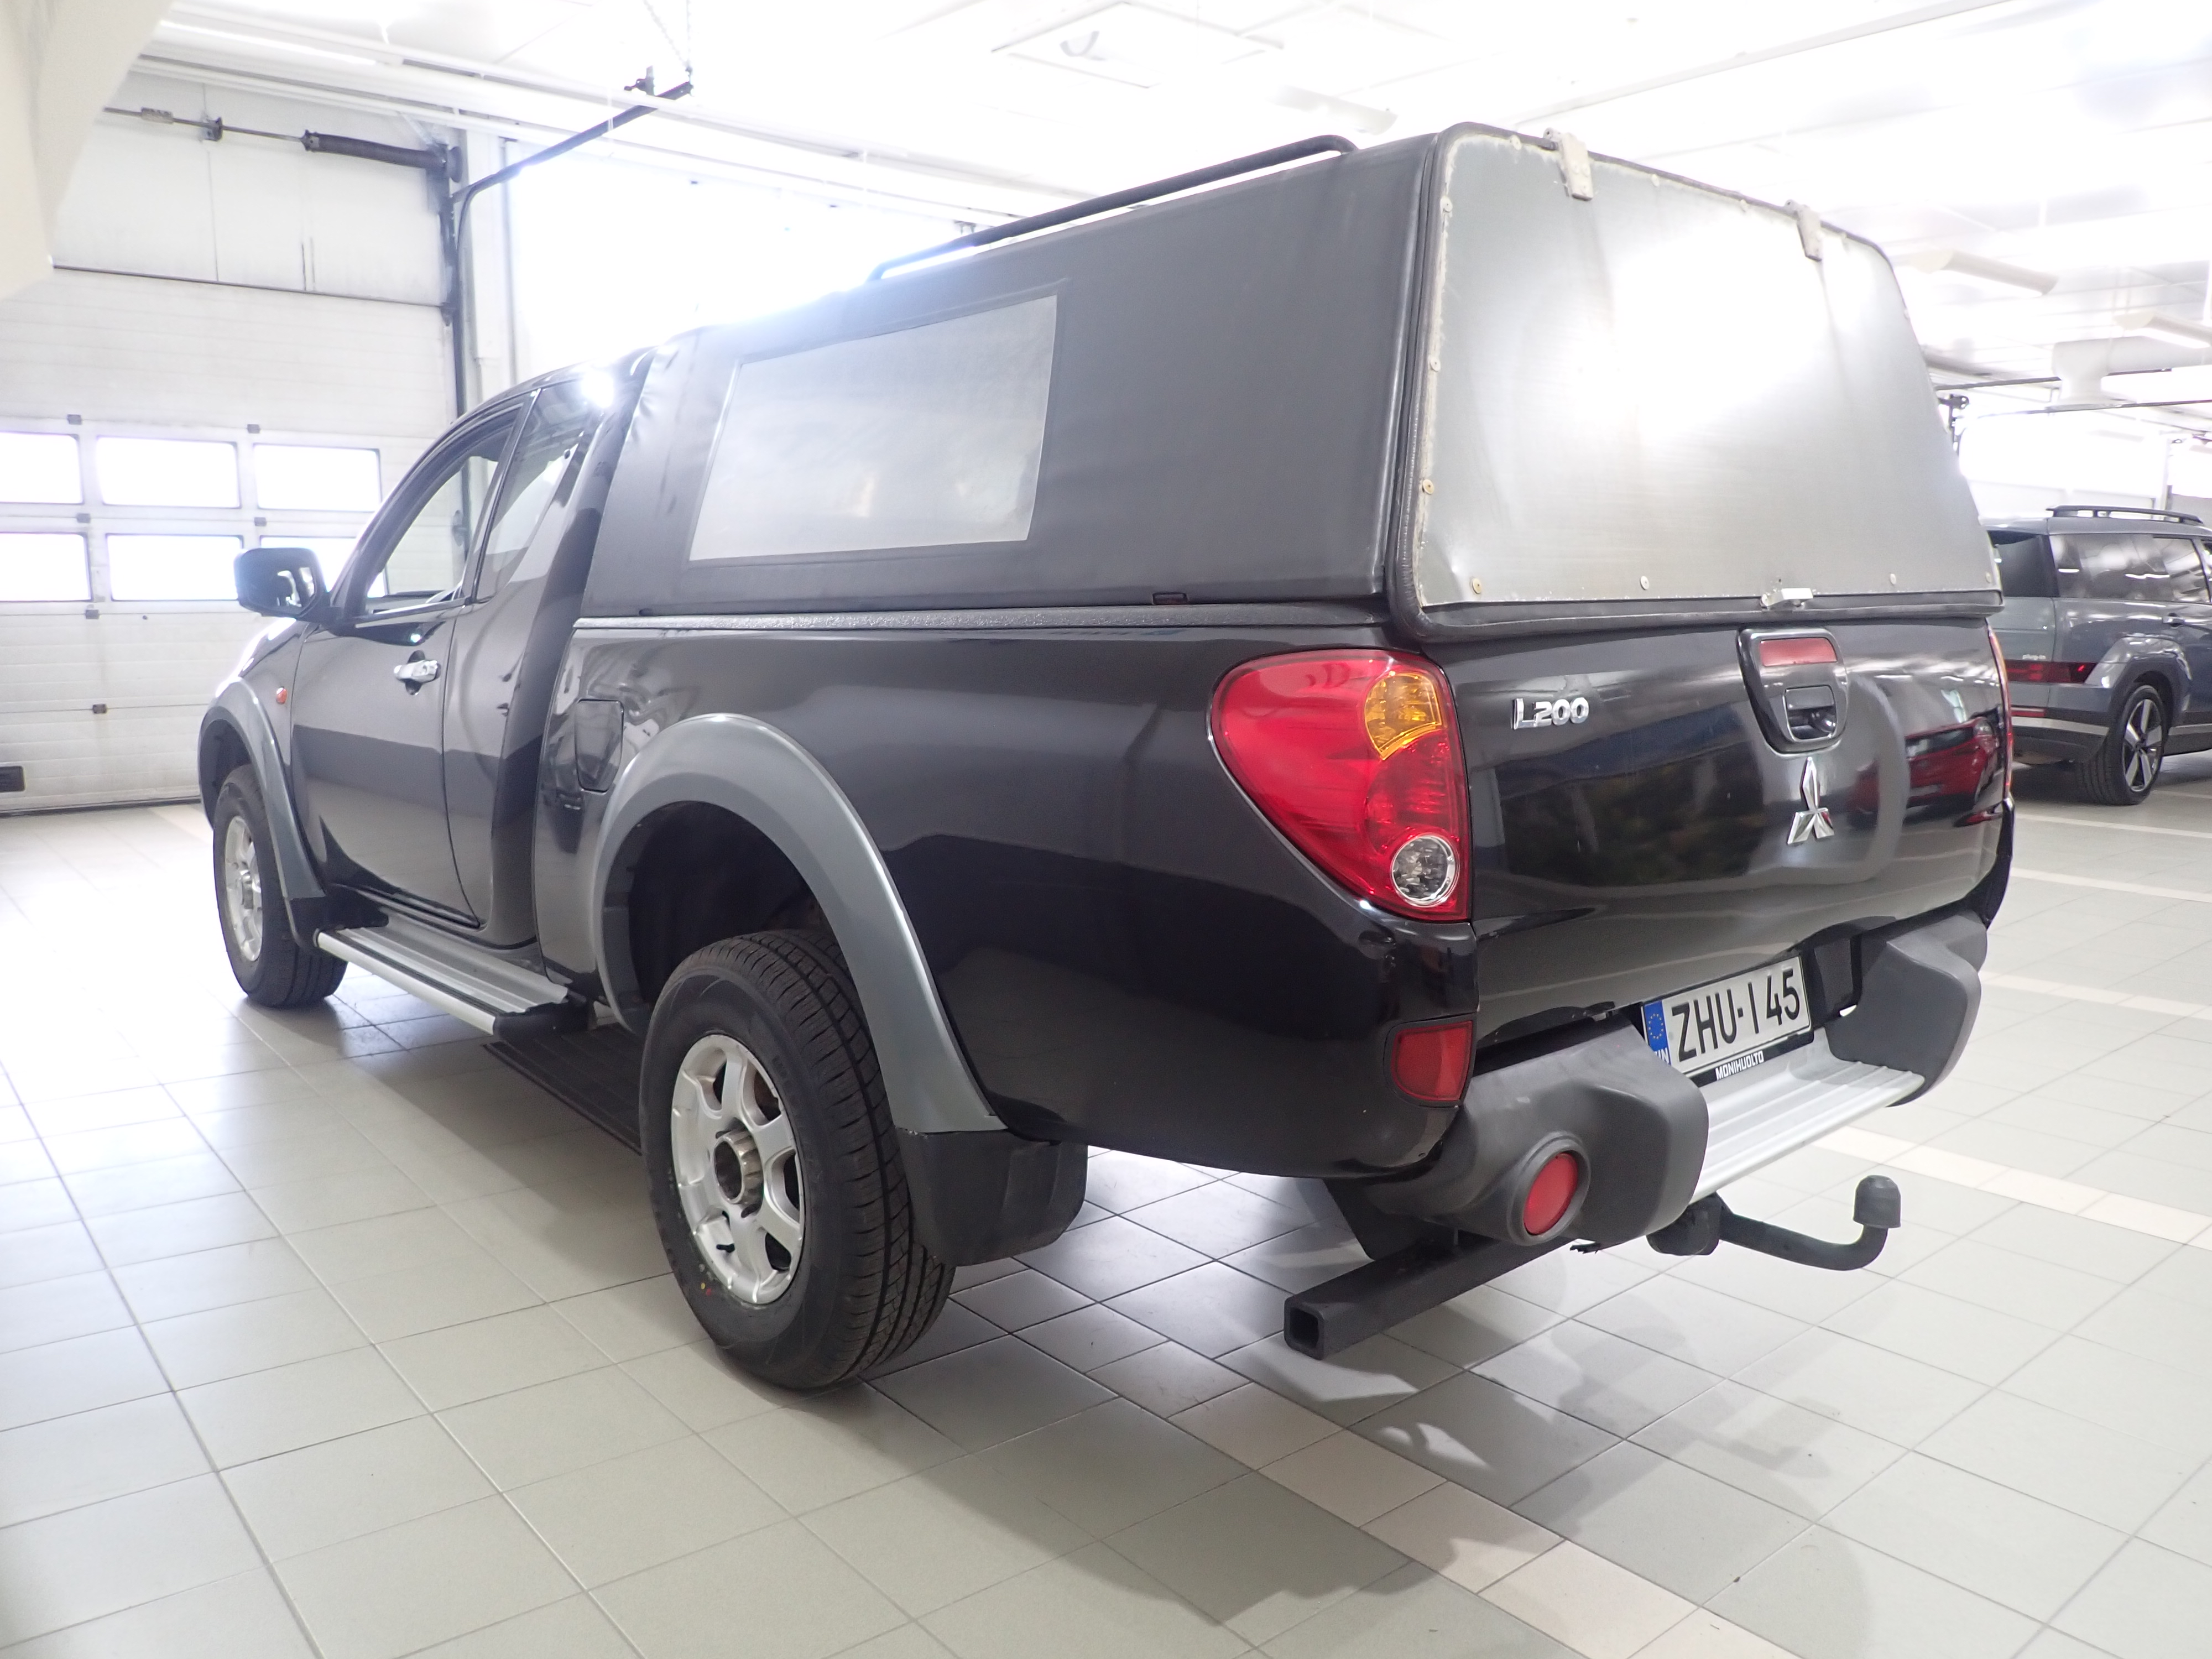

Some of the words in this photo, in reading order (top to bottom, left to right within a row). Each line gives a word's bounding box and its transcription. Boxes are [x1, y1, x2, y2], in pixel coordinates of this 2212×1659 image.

[1512, 697, 1589, 730] L200
[1654, 1047, 1670, 1064] IN
[1715, 1050, 1764, 1080] MONIHUOLTO
